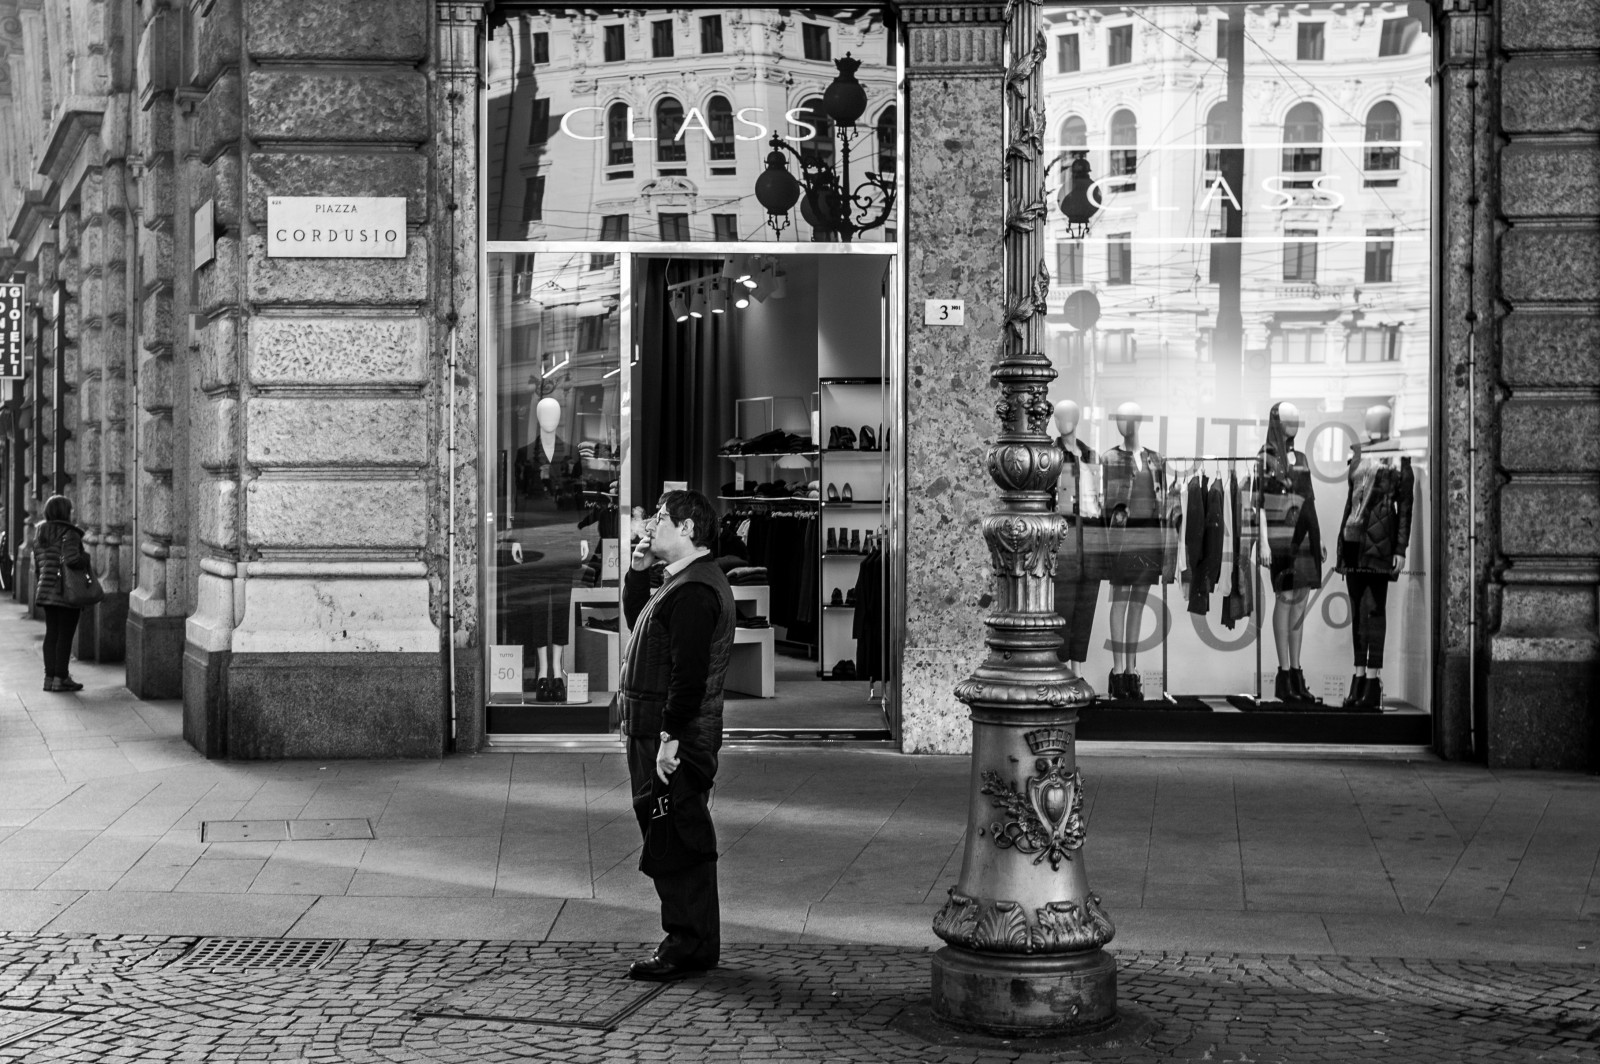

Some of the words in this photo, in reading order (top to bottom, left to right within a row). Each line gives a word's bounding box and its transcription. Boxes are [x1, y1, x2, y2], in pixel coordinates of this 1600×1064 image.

[560, 107, 817, 141] CLASS
[315, 204, 358, 213] PIAZZA
[1086, 175, 1345, 211] CLASS
[276, 229, 397, 242] CORDUSIO
[9, 286, 20, 375] GIOIELLI
[1108, 414, 1361, 484] TUTTO
